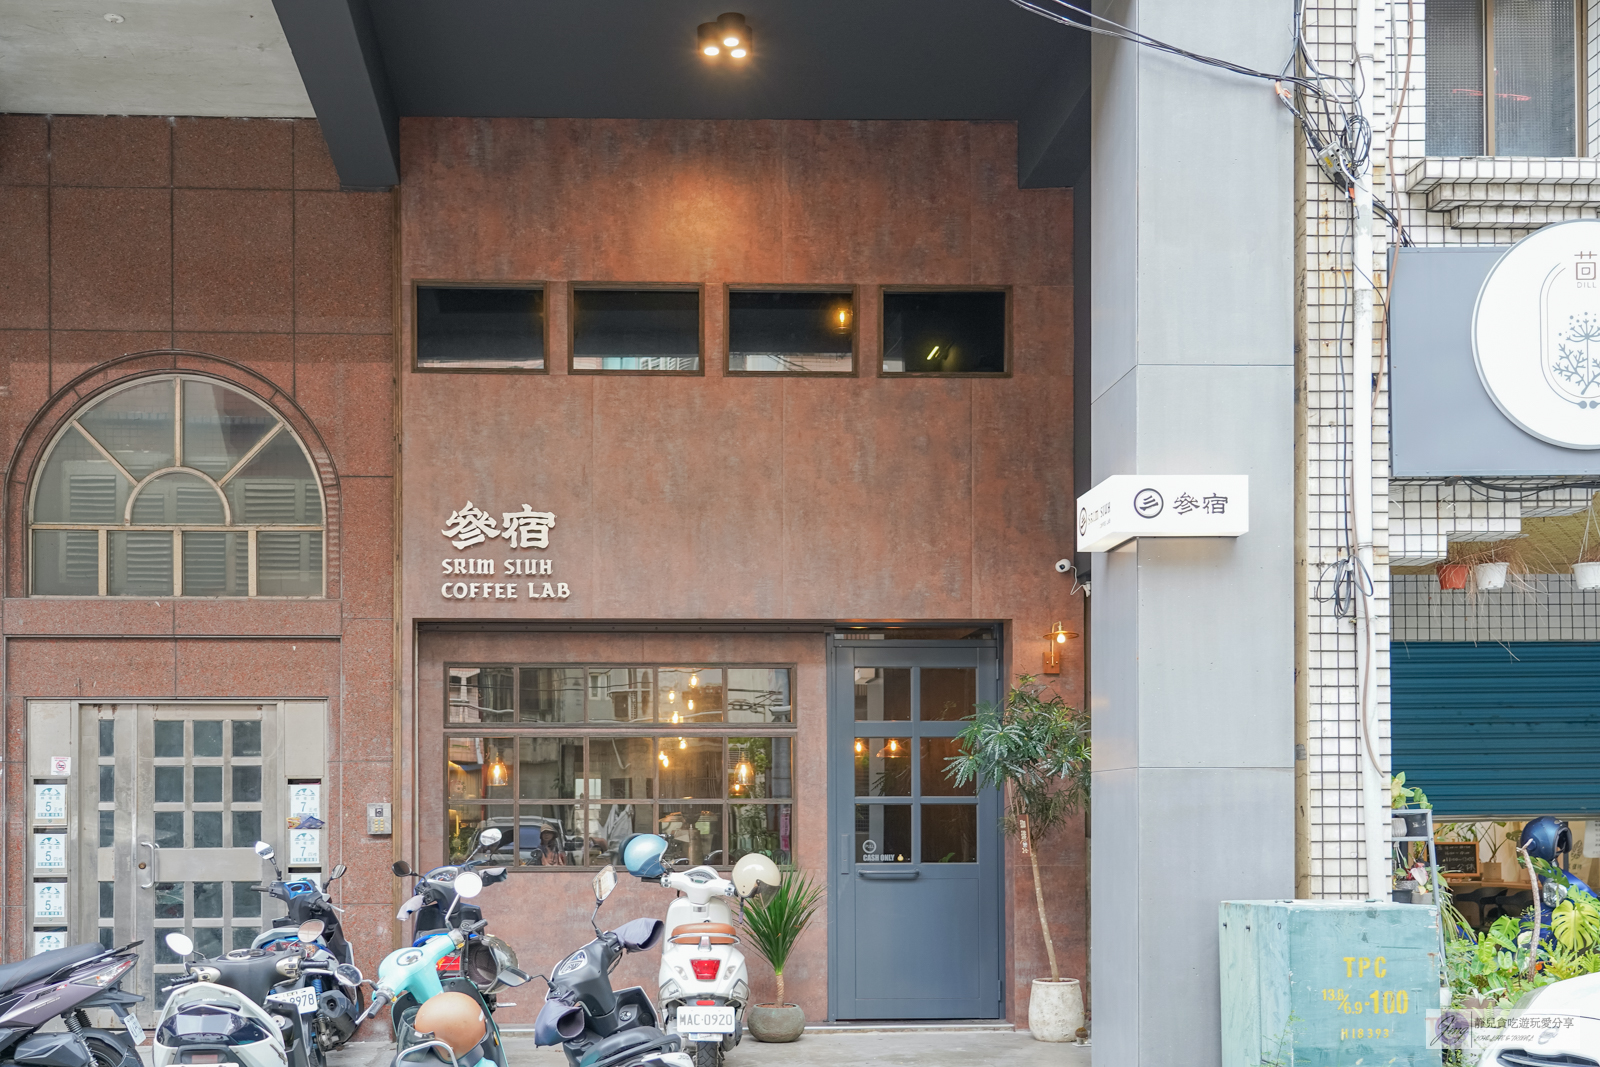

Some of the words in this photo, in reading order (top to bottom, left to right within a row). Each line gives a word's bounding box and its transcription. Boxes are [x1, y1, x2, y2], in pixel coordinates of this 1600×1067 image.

[1173, 492, 1229, 515] 參宿
[441, 500, 557, 550] 參宿
[441, 559, 495, 575] SRIM
[504, 559, 553, 575] SIUH
[441, 582, 518, 599] COFFEE
[527, 582, 571, 599] LAB
[46, 802, 51, 812] 5
[301, 802, 306, 812] 7
[46, 851, 51, 861] 5
[301, 847, 306, 857] 7
[45, 900, 51, 910] 5
[1343, 956, 1387, 978] TPC
